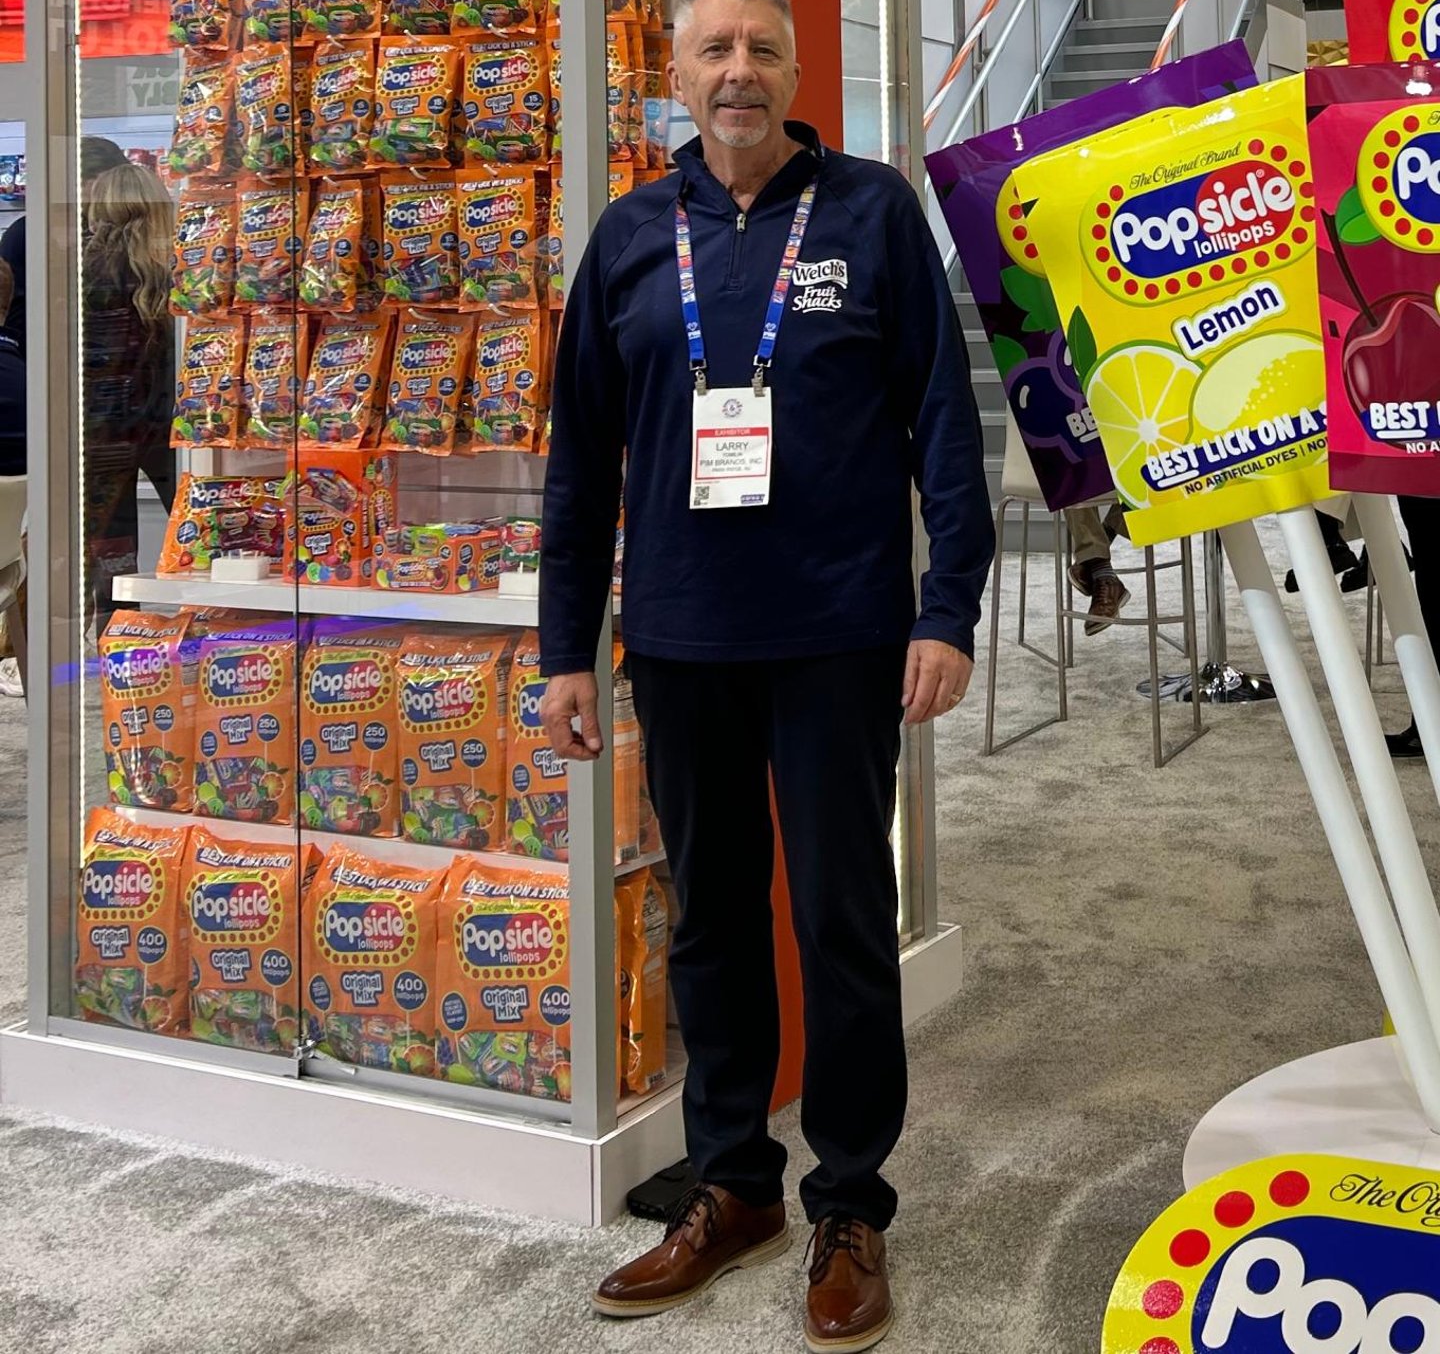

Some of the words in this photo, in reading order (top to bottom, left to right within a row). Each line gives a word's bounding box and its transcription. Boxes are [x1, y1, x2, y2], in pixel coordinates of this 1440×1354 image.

[1129, 174, 1152, 190] The
[1153, 157, 1199, 183] Original
[1200, 142, 1242, 167] Brand
[1194, 220, 1275, 258] lollipops
[795, 261, 845, 281] Welch's
[804, 286, 837, 299] Fruit
[792, 295, 842, 310] Snacks
[1181, 287, 1280, 351] Lemon
[1369, 401, 1431, 430] BEST
[716, 441, 749, 452] LARRY
[1147, 445, 1199, 482] BEST
[1201, 428, 1257, 464] LICK
[1257, 416, 1297, 446] ON
[1300, 407, 1320, 435] A
[1406, 442, 1427, 454] NO
[1185, 481, 1204, 495] NO
[1206, 460, 1265, 489] ARTIFICIAL
[1266, 448, 1298, 468] DYES
[258, 719, 278, 730] 250
[365, 726, 386, 737] 250
[463, 743, 485, 755] 250
[138, 933, 164, 946] 400
[263, 955, 288, 968] 400
[500, 951, 540, 964] lollipops
[397, 978, 423, 991] 400
[542, 993, 570, 1007] 400
[1329, 1173, 1397, 1208] The
